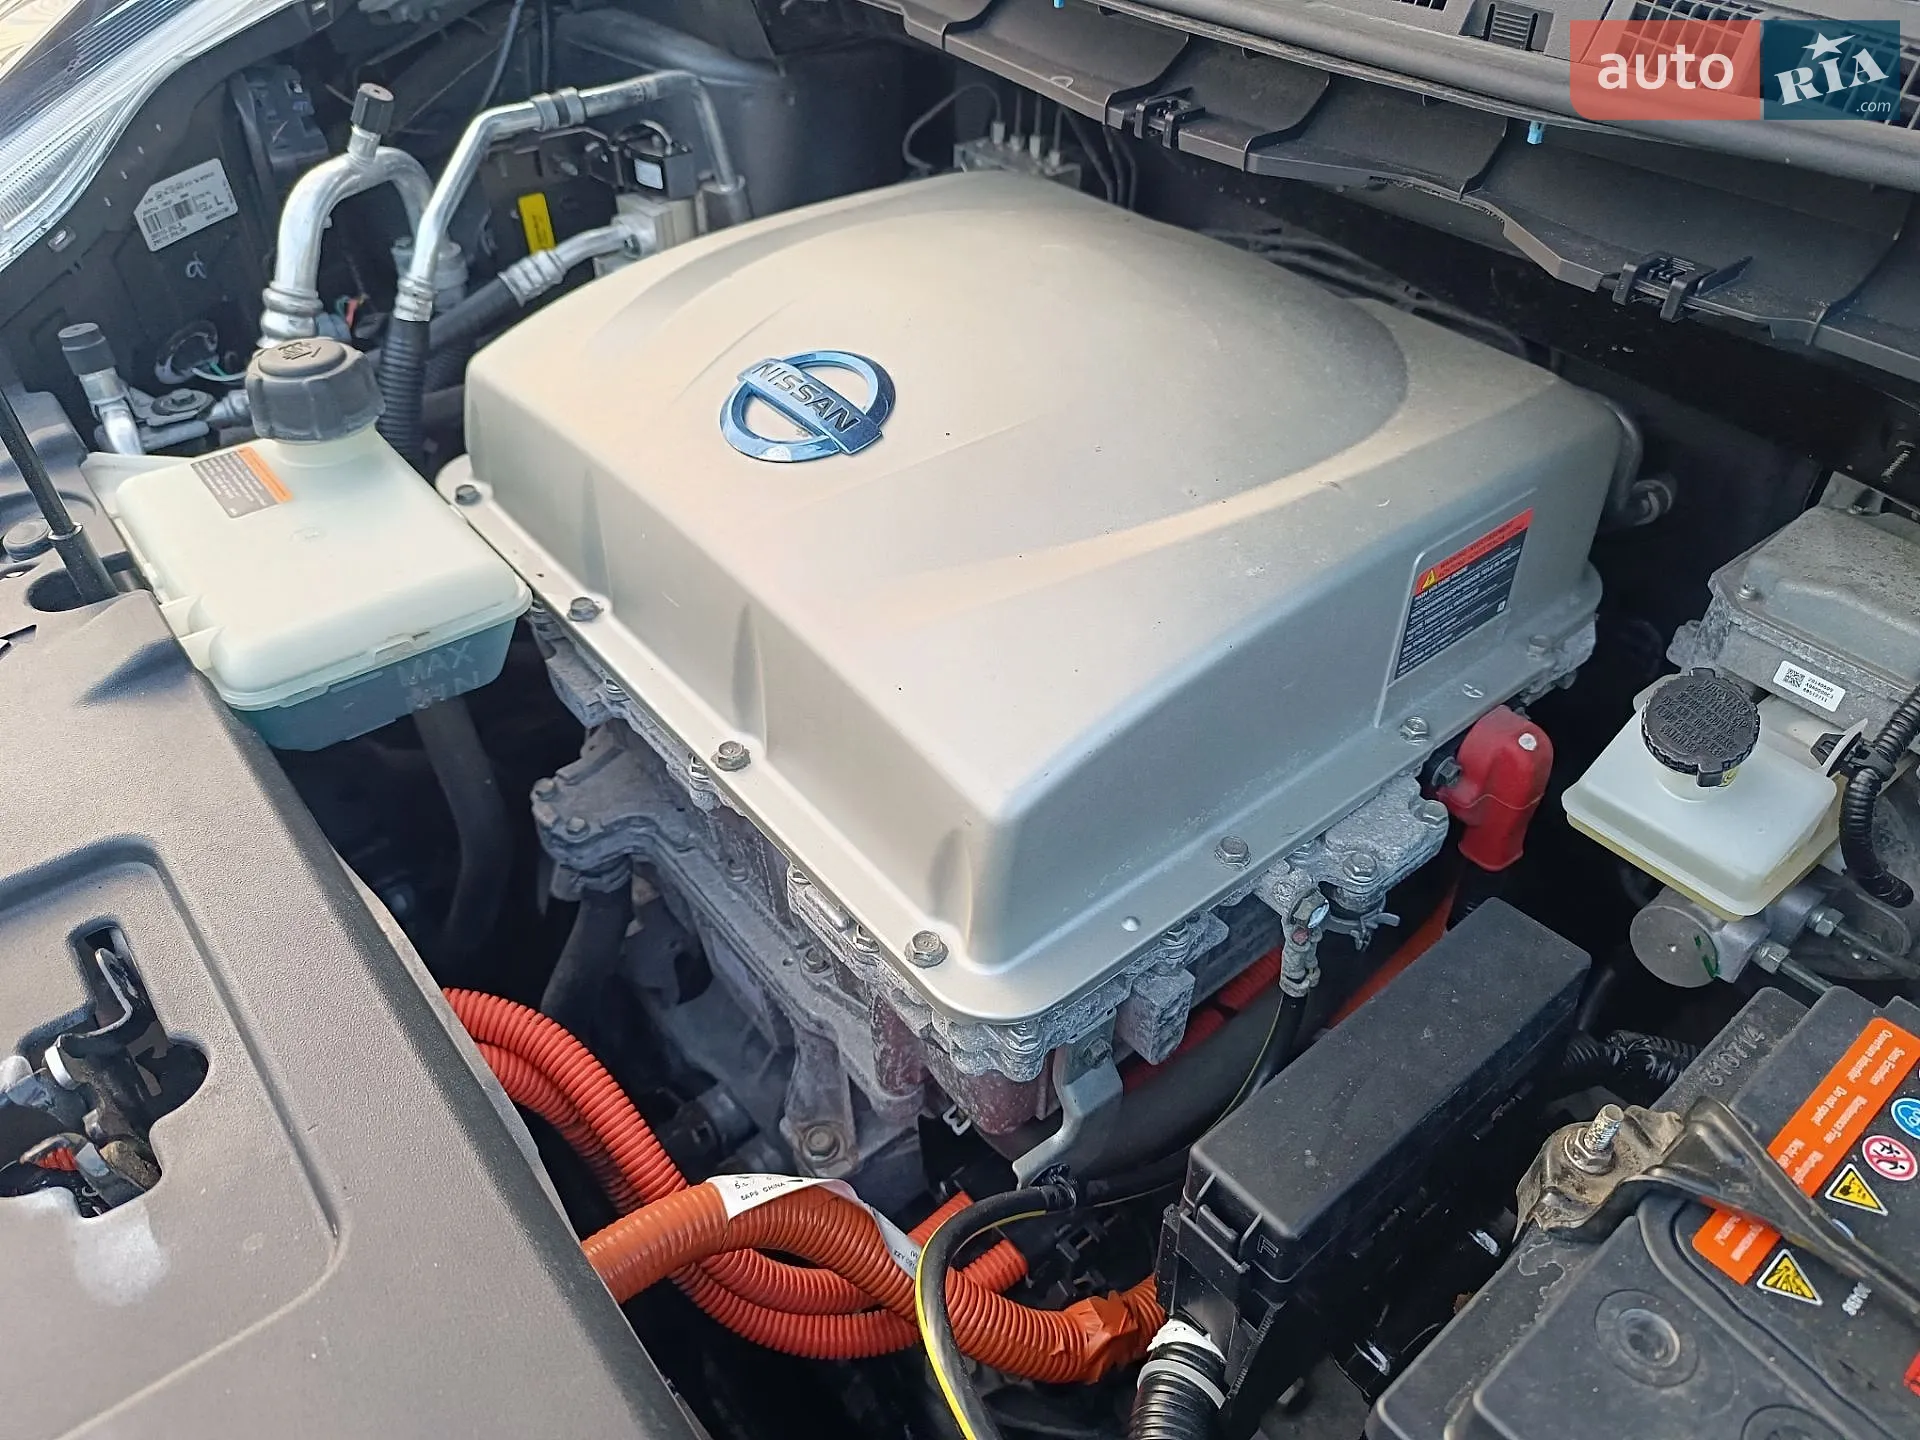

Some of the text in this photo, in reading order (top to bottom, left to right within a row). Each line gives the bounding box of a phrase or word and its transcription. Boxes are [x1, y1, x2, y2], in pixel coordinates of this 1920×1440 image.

[751, 362, 861, 434] NISSAN
[396, 641, 475, 686] MAX
[1834, 1085, 1848, 1097] Do
